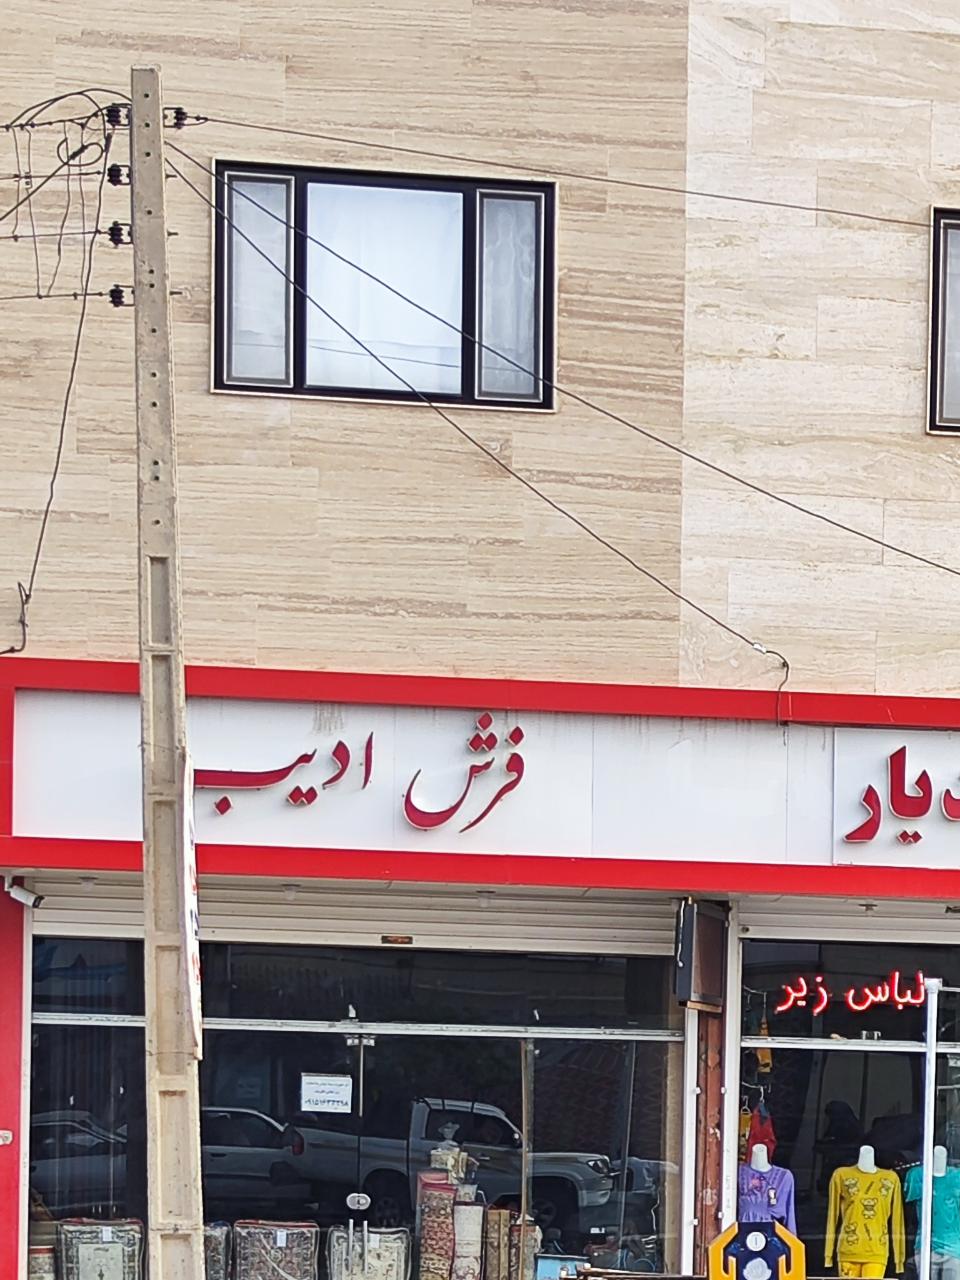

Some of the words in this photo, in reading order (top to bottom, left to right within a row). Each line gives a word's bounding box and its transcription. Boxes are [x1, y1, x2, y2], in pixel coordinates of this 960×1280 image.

[193, 731, 374, 816] ادیب
[403, 711, 525, 833] فرش
[774, 975, 829, 1016] زیر
[848, 970, 925, 1011] لباس
